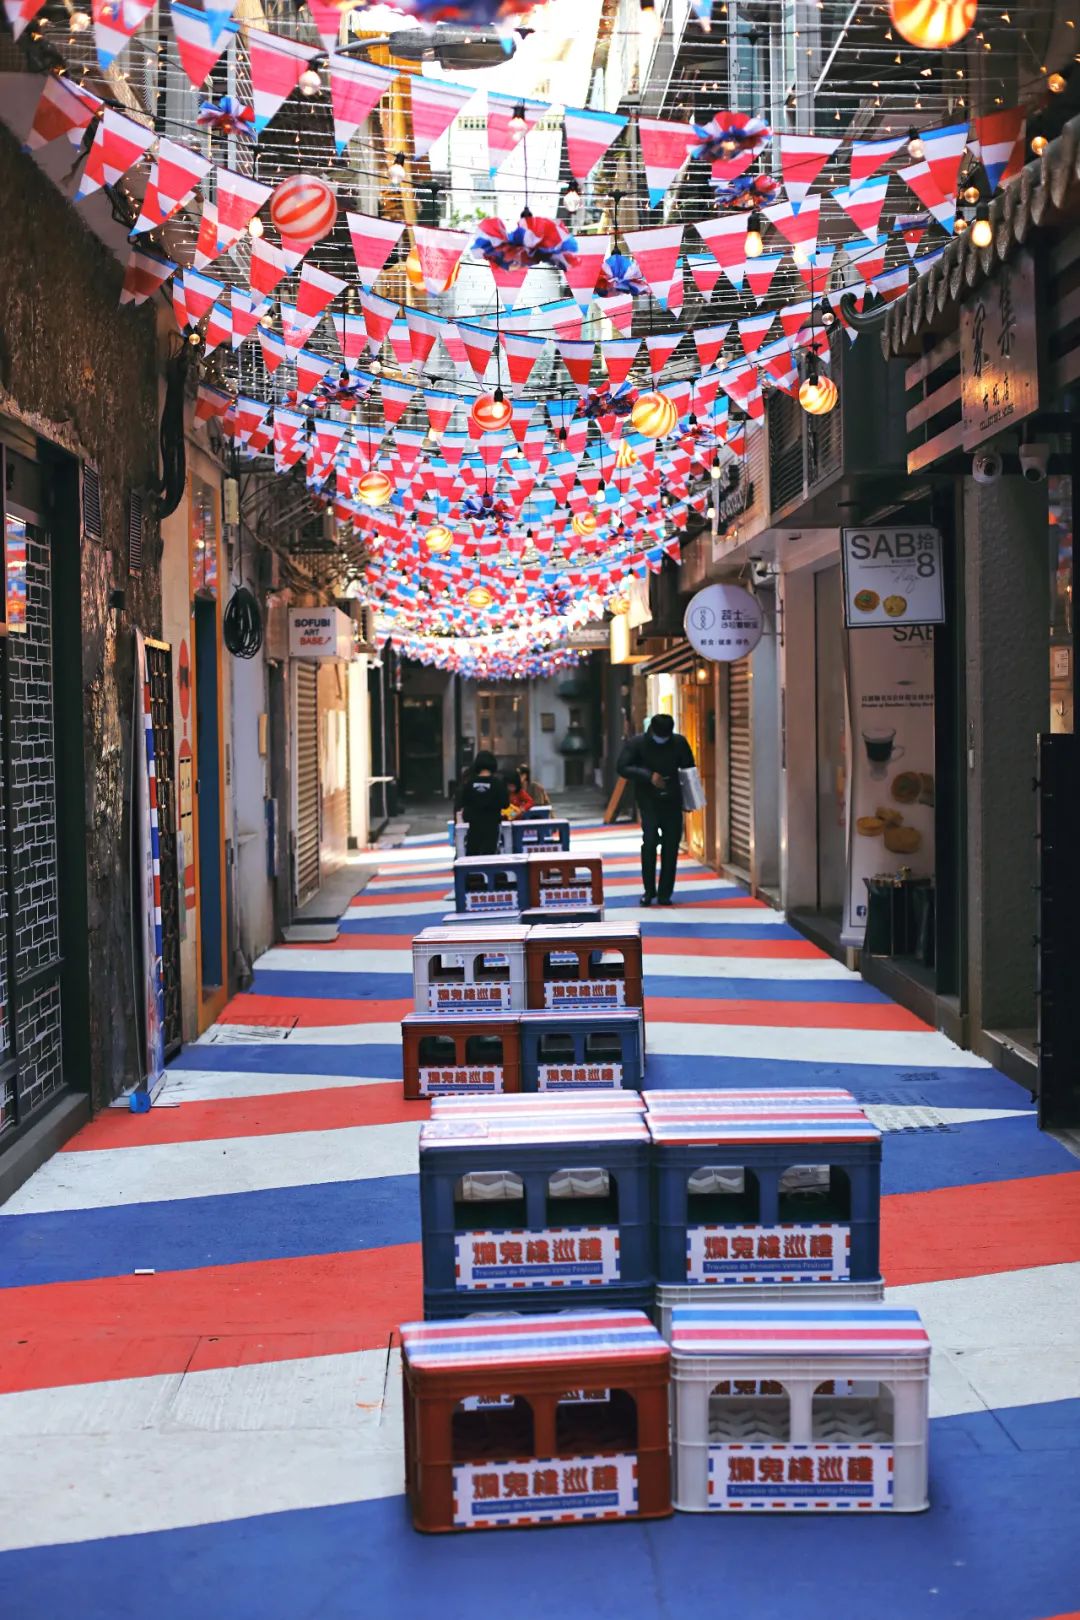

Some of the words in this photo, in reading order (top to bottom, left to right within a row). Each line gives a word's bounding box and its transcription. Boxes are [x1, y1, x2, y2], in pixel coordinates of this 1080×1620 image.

[851, 533, 916, 560] SAB
[917, 552, 935, 577] 8
[295, 619, 330, 627] SOFUBI
[300, 637, 324, 645] BASE
